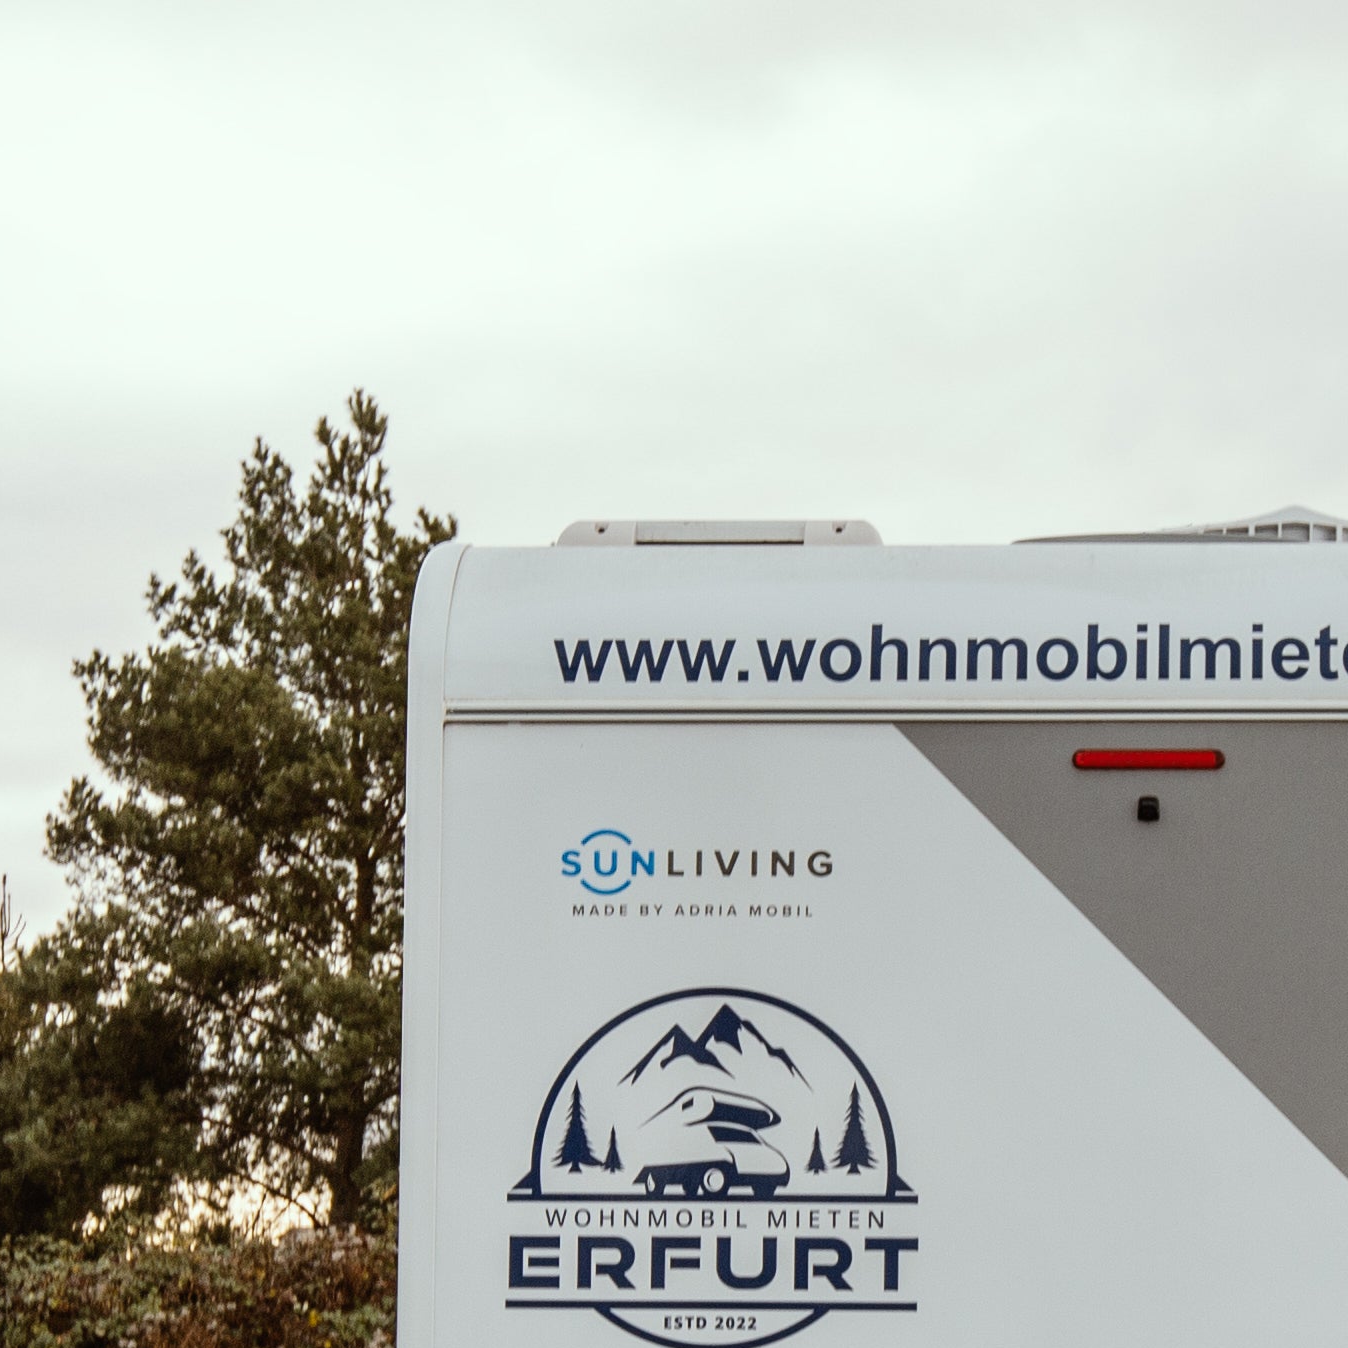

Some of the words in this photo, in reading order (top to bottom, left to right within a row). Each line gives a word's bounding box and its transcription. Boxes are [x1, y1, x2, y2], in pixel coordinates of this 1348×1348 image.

[561, 849, 833, 878] SUNLIVING
[572, 903, 628, 917] MADE
[639, 903, 663, 917] BY
[674, 903, 738, 917] ADRIA
[749, 904, 813, 918] MOBIL
[545, 1208, 747, 1229] WOHNMOBIL
[767, 1209, 884, 1230] MIETEN
[508, 1235, 919, 1292] ERFURT
[663, 1315, 708, 1330] ESTD
[714, 1316, 757, 1331] 2022
